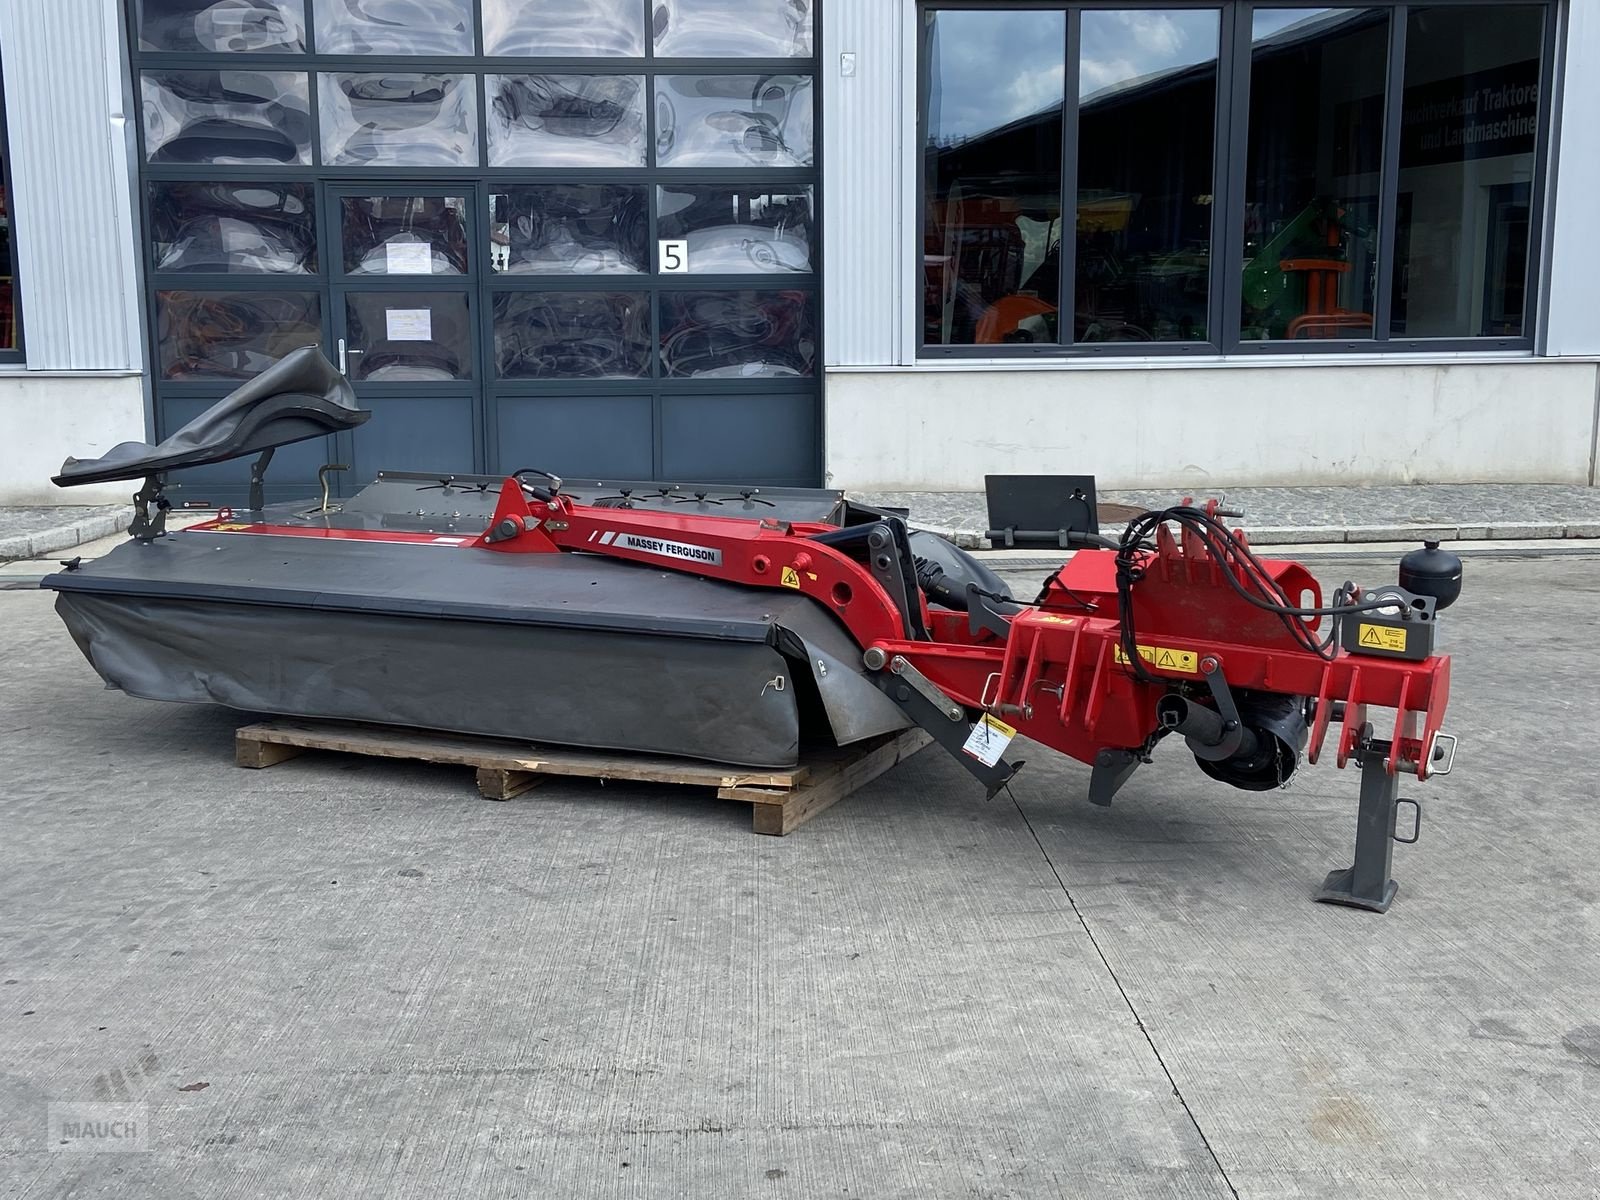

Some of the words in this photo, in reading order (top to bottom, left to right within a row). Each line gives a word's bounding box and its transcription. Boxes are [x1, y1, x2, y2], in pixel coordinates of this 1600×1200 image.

[665, 244, 681, 270] 5
[627, 536, 664, 552] MASSEY
[666, 544, 715, 562] FERGUSON
